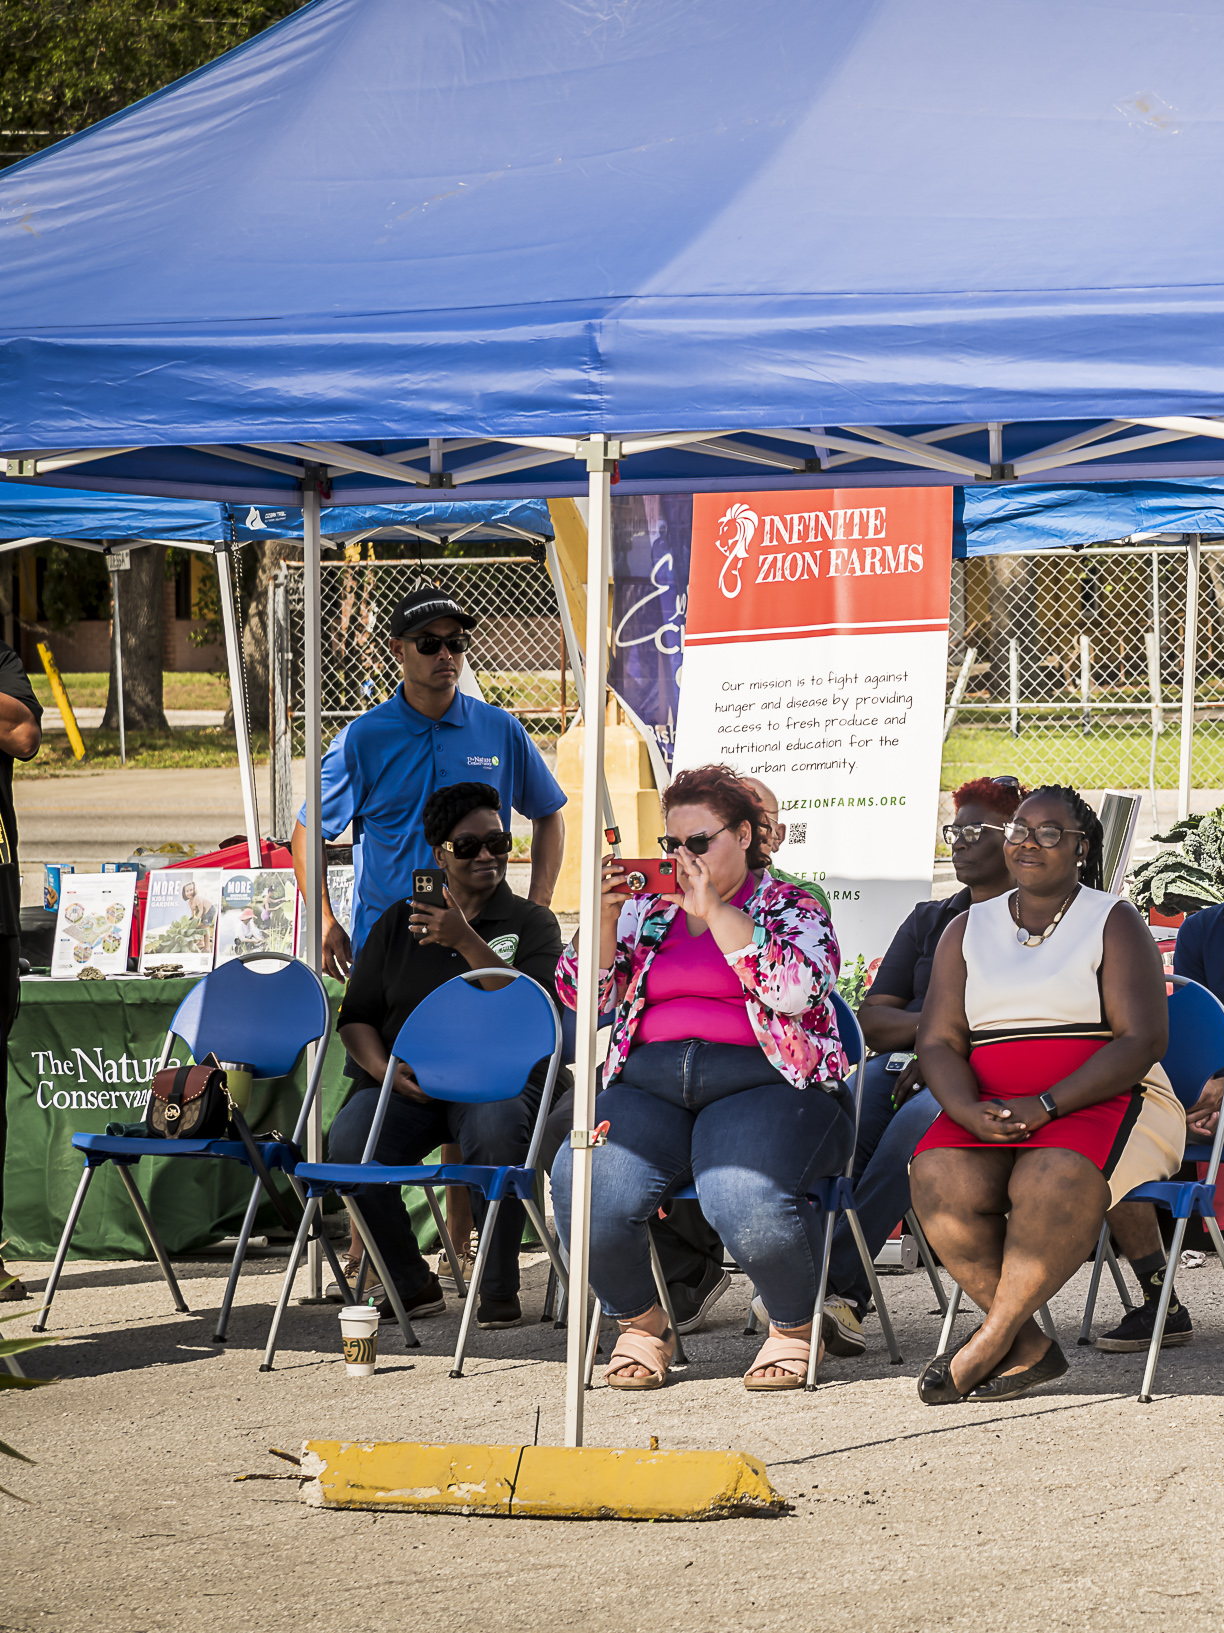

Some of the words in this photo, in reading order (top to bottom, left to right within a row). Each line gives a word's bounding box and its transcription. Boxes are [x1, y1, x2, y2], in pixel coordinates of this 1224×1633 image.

[760, 507, 886, 546] INFINITE
[755, 550, 822, 583] ZION
[826, 544, 924, 577] FARMS
[722, 681, 744, 691] Our
[749, 679, 792, 690] mission
[797, 677, 805, 687] is
[811, 675, 823, 686] to
[828, 671, 859, 690] fight
[864, 671, 909, 689] against
[714, 702, 755, 718] hunger
[761, 697, 781, 710] and
[786, 696, 828, 709] disease
[832, 694, 849, 711] by
[855, 691, 913, 710] providing
[717, 722, 762, 733] access
[767, 720, 780, 731] to
[786, 716, 820, 730] fresh
[824, 714, 878, 732] produce
[884, 712, 906, 725] and
[721, 741, 781, 754] nutritional
[786, 738, 842, 751] education
[849, 734, 873, 747] for
[879, 736, 899, 747] the
[750, 762, 786, 774] urban
[791, 758, 858, 774] community.
[778, 796, 906, 809] ITEZIONFARMS.ORG
[813, 872, 826, 881] TO
[152, 881, 181, 896] MORE
[227, 881, 252, 894] MORE
[827, 890, 860, 900] ARMS
[31, 1050, 75, 1075] The
